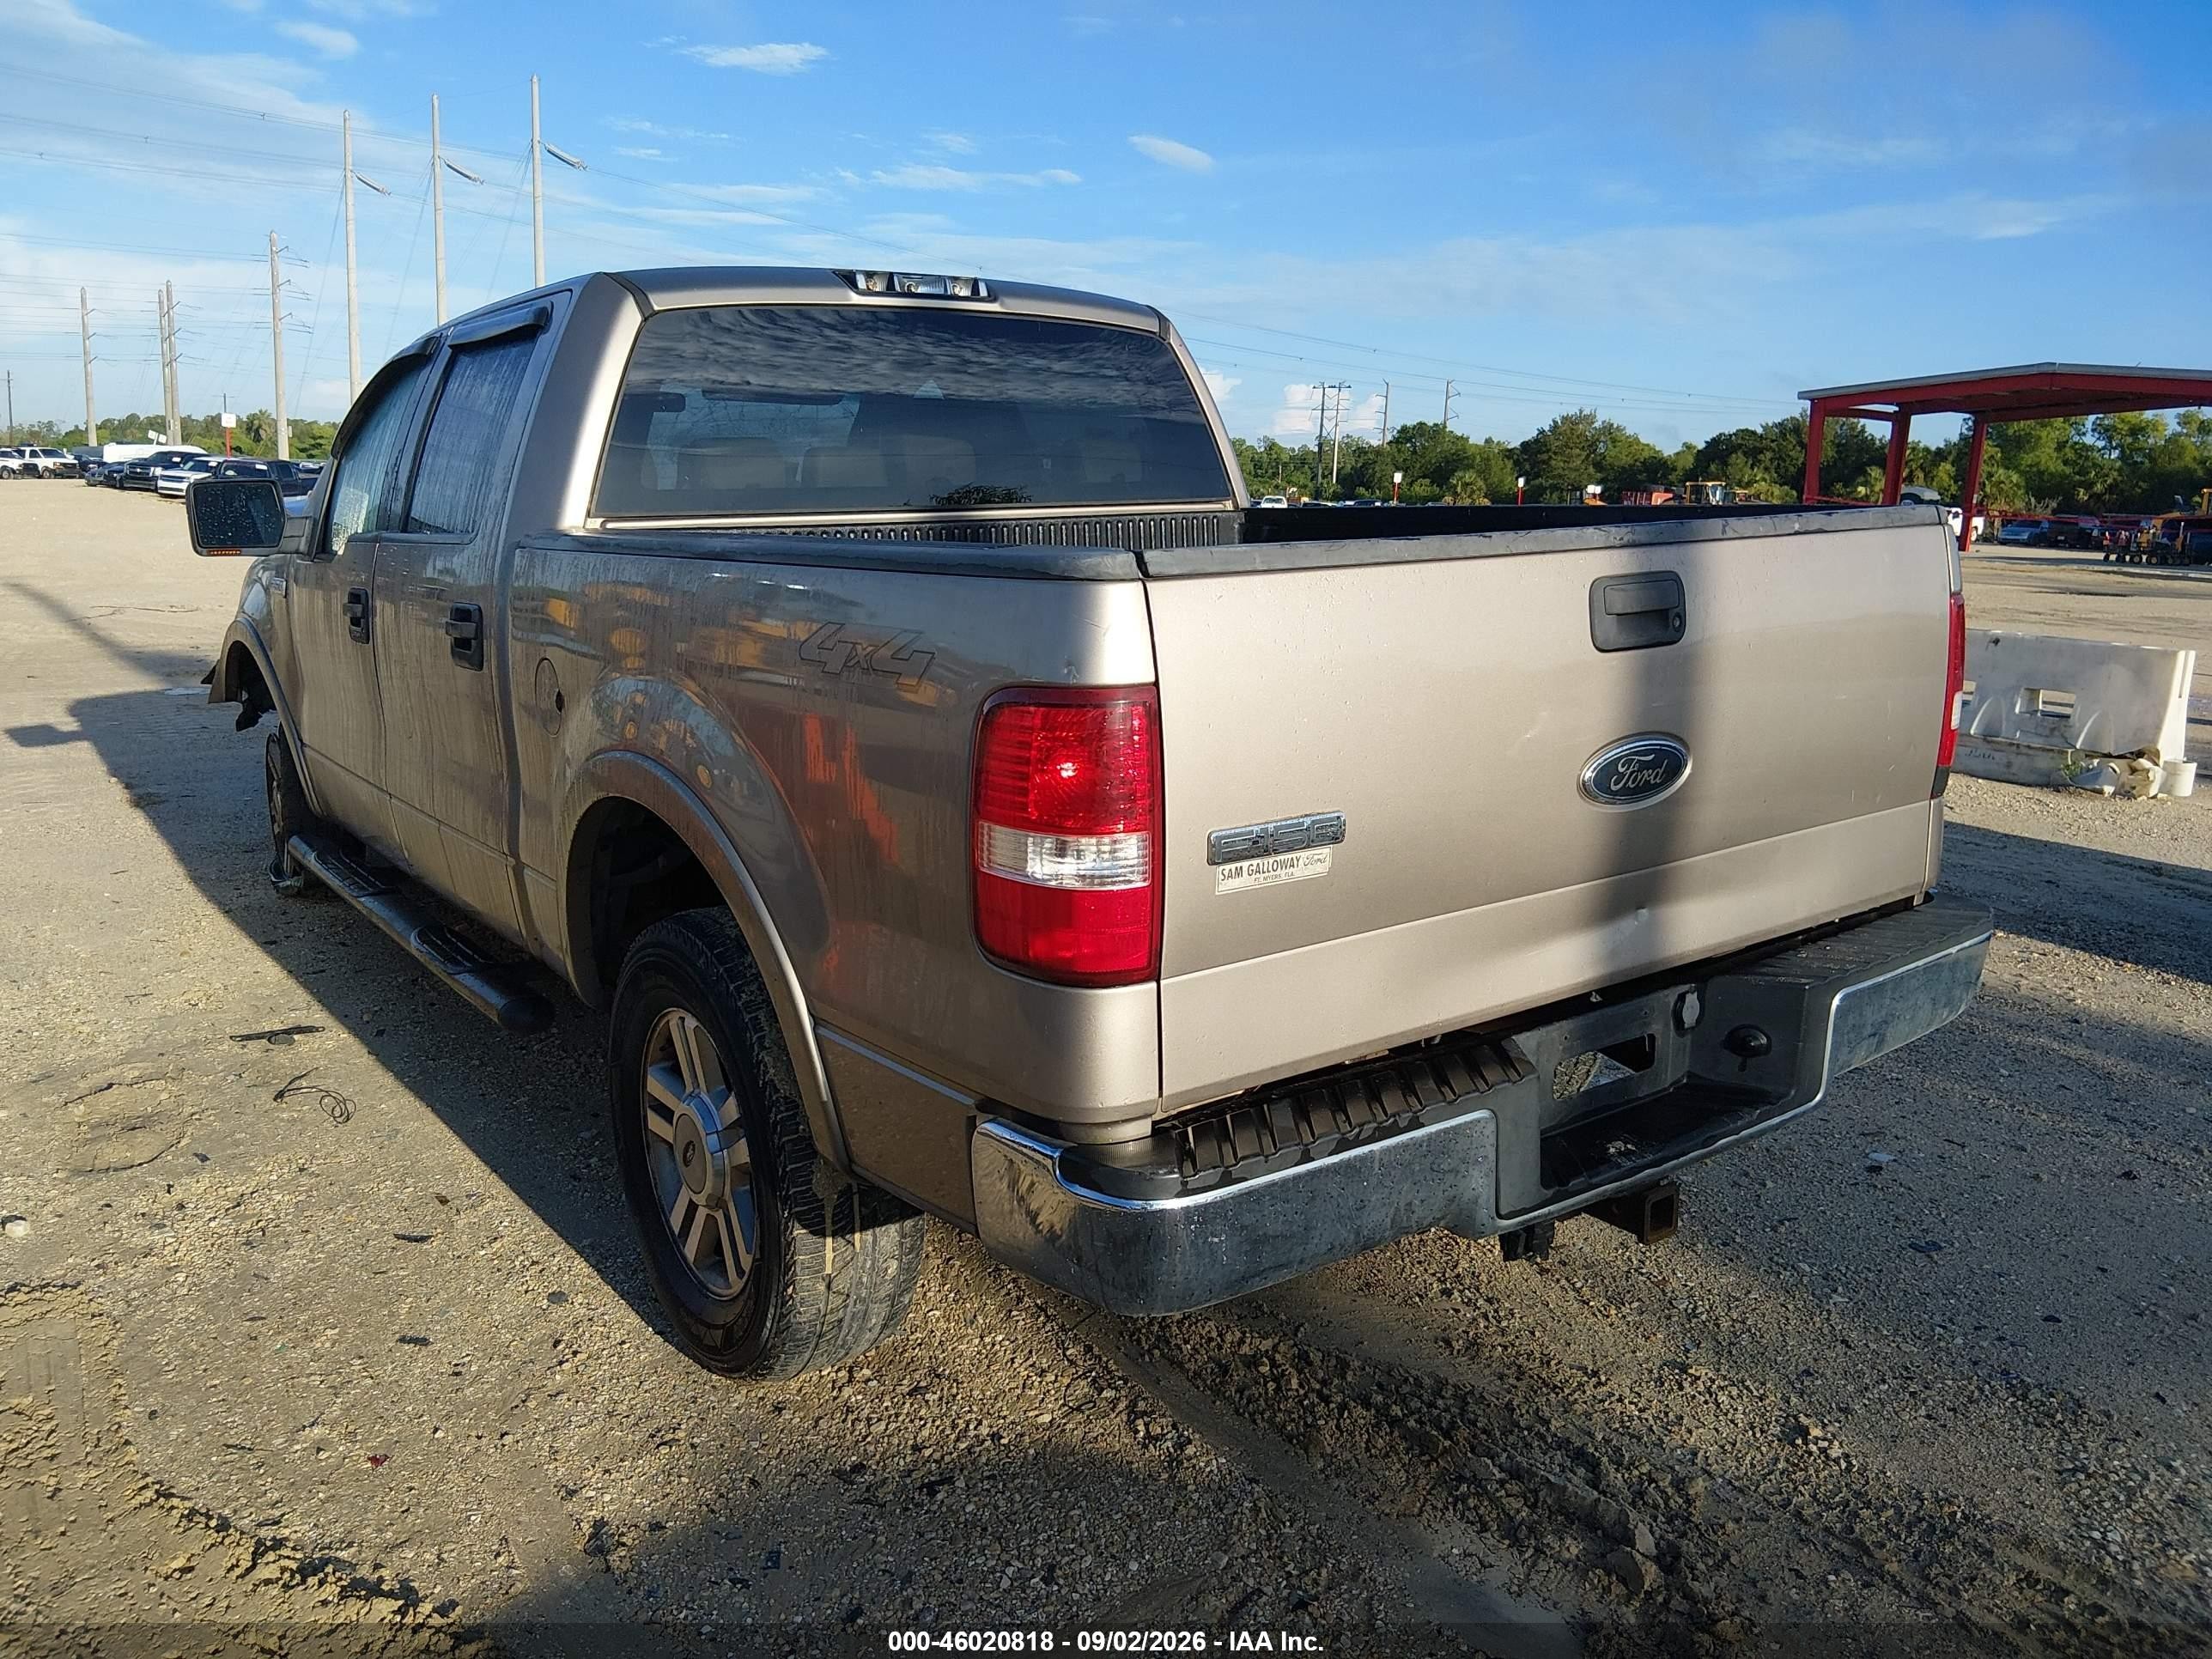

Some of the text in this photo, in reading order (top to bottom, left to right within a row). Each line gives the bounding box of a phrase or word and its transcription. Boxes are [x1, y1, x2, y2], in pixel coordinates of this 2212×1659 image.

[1610, 754, 1668, 792] Ford
[1220, 854, 1329, 882] SAM GALLOWAY Ford
